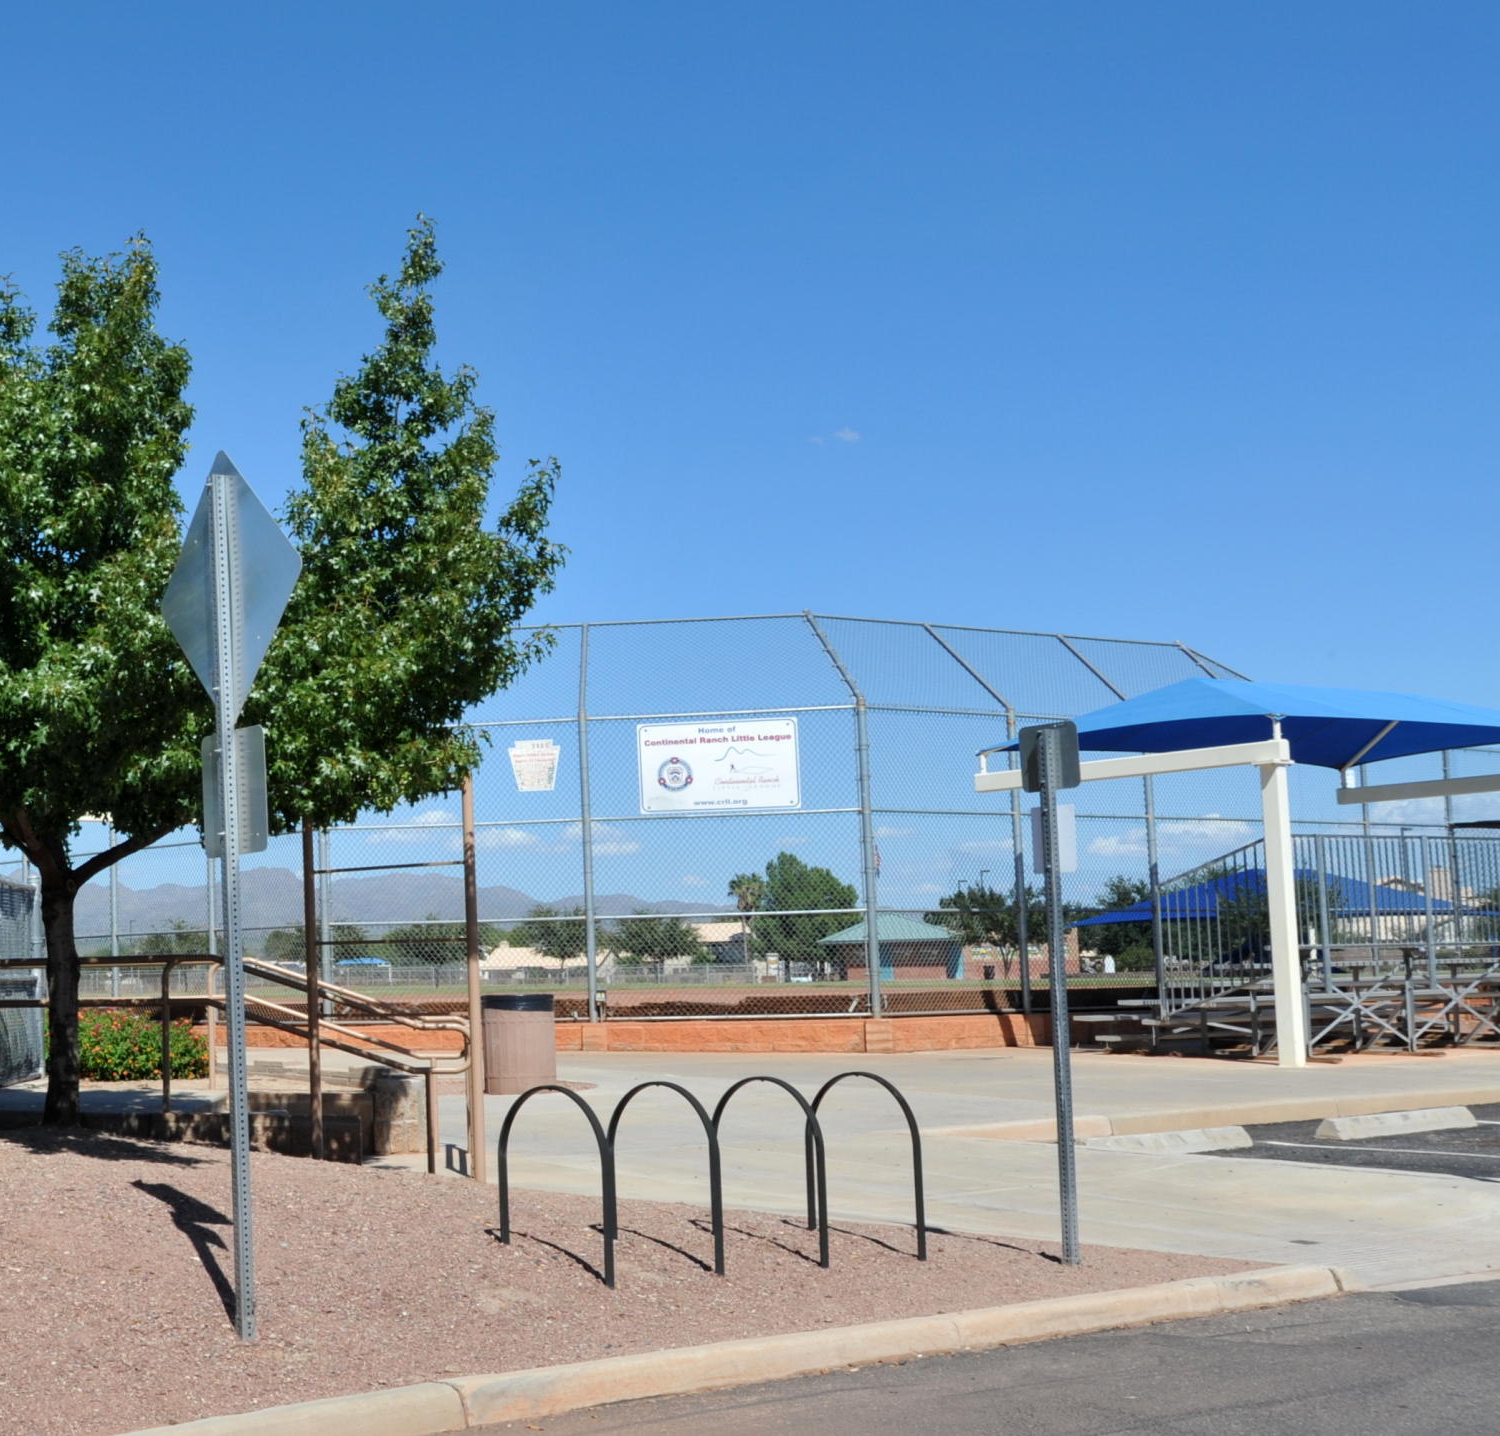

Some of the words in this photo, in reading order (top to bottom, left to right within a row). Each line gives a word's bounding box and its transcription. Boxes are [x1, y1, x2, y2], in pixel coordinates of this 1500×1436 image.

[644, 738, 697, 747] Continental
[700, 736, 729, 744] Ranch
[731, 735, 755, 743] Little
[757, 734, 792, 742] League
